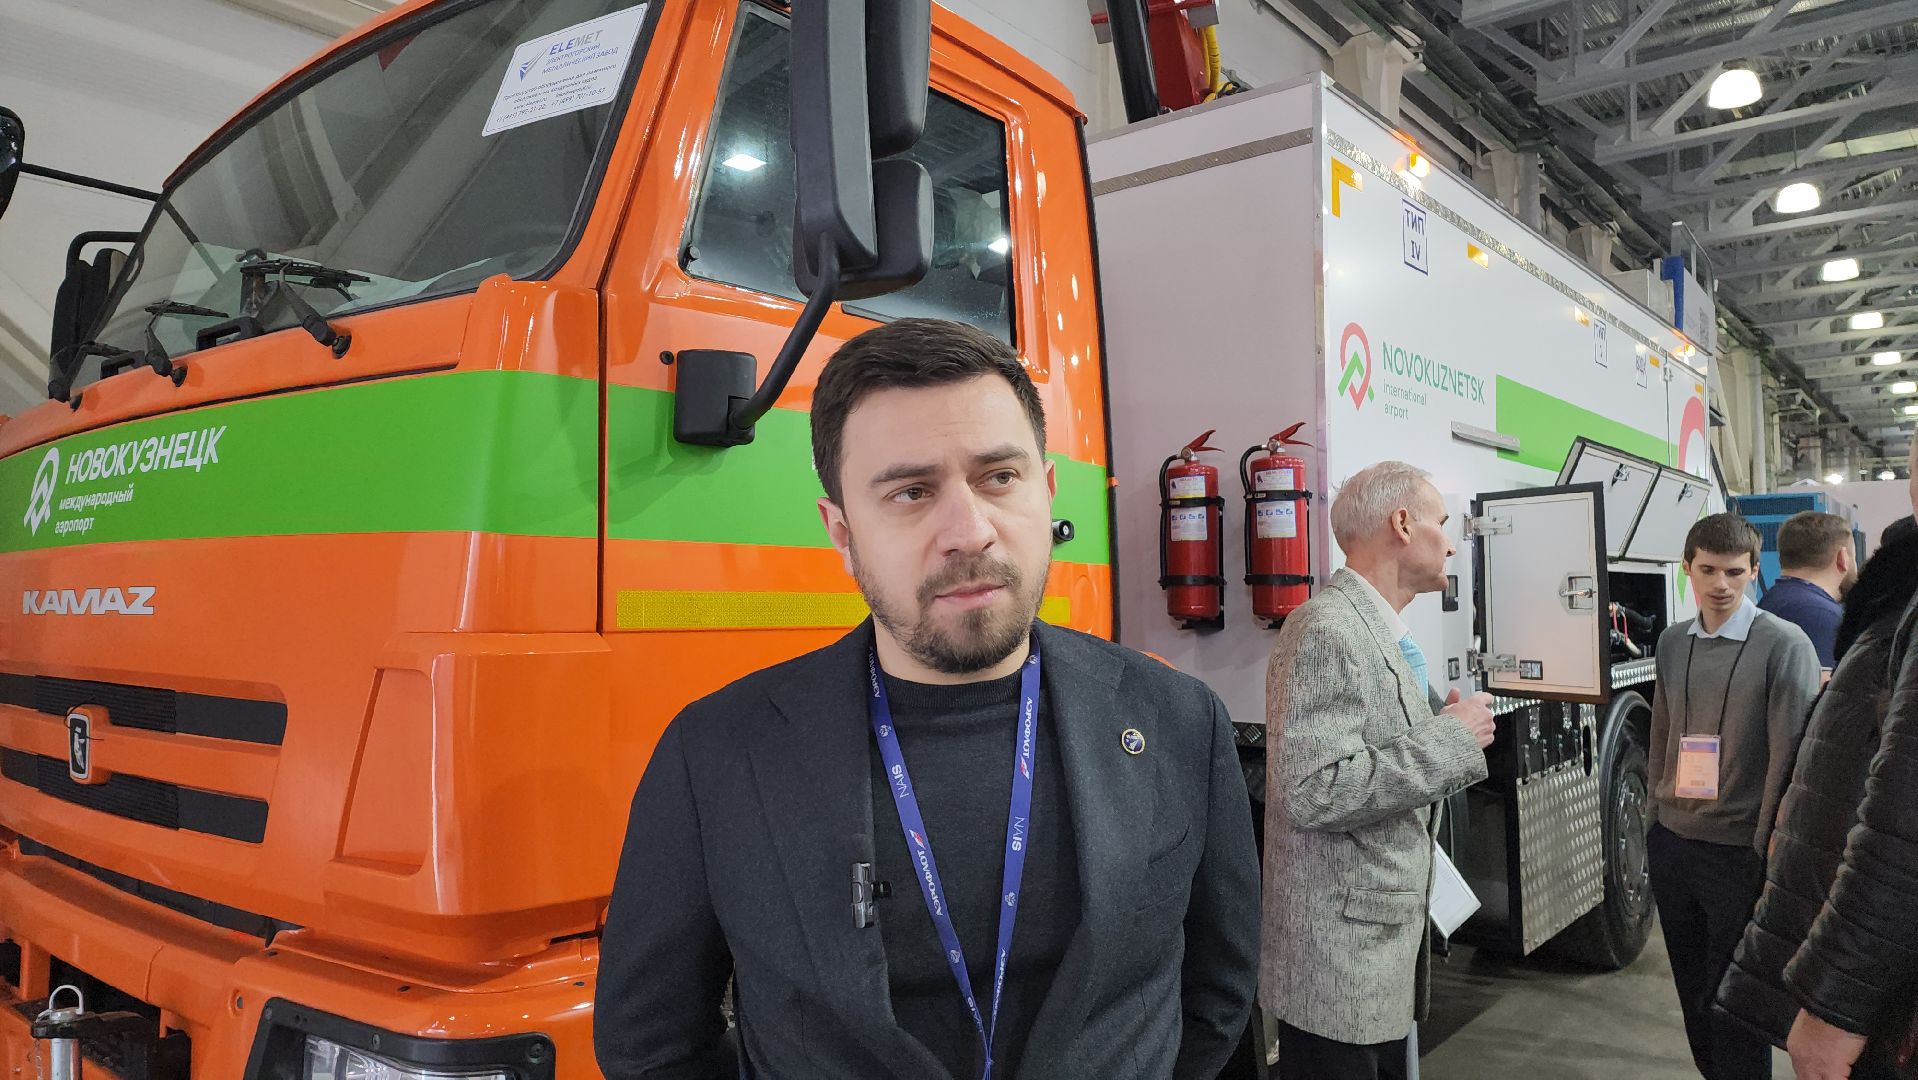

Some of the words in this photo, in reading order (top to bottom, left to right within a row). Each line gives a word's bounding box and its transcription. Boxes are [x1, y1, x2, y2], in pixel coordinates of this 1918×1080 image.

[549, 29, 603, 56] ELEMET
[1404, 208, 1425, 236] ТИП
[1411, 240, 1421, 261] IV
[1383, 341, 1485, 405] NOVOKUZNETSK
[1383, 379, 1427, 406] international
[1384, 401, 1409, 420] airport
[64, 425, 227, 485] НОВОКУЗНЕЦК
[58, 483, 135, 512] международный
[55, 517, 95, 537] аэропорт
[22, 586, 157, 615] KAMAZ
[1021, 696, 1033, 759] АЭРОФЛОТ
[891, 764, 910, 798] NAIS
[1011, 816, 1025, 851] NAIS
[917, 849, 944, 916] АЭРОФЛОТ
